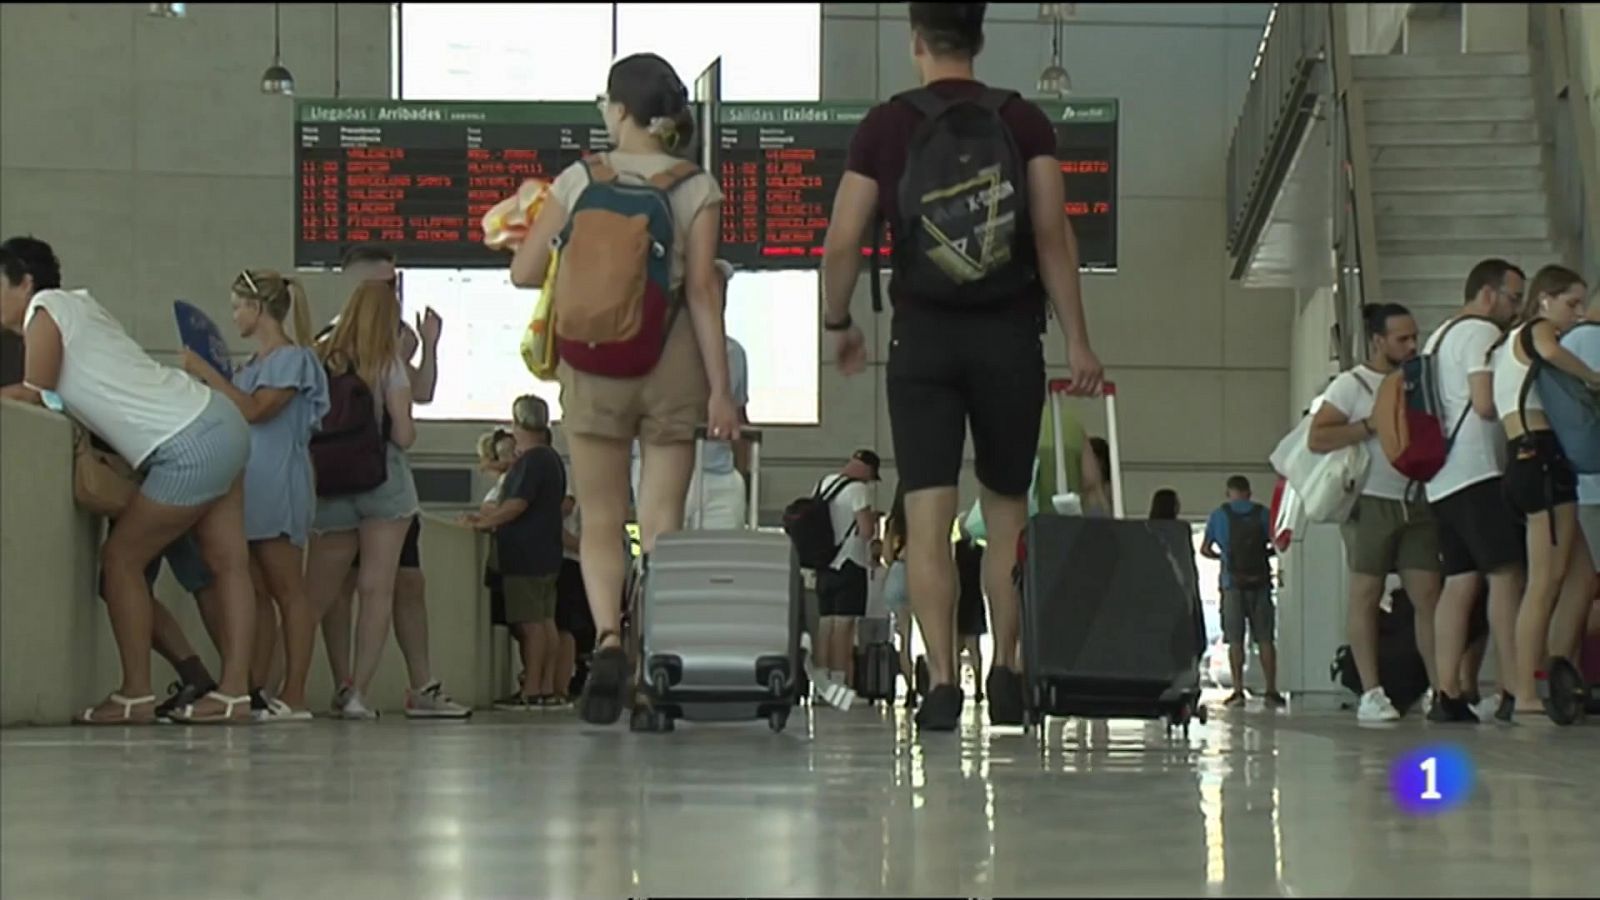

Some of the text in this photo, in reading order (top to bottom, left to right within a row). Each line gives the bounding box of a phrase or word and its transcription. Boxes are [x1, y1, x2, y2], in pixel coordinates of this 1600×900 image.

[310, 107, 367, 122] Llegadas
[378, 107, 441, 121] Arribades
[729, 107, 774, 121] Salidas
[783, 107, 828, 121] Eixides
[347, 175, 412, 187] BARCELONA
[766, 176, 823, 187] VALENCIA
[347, 189, 405, 200] VALENCIA
